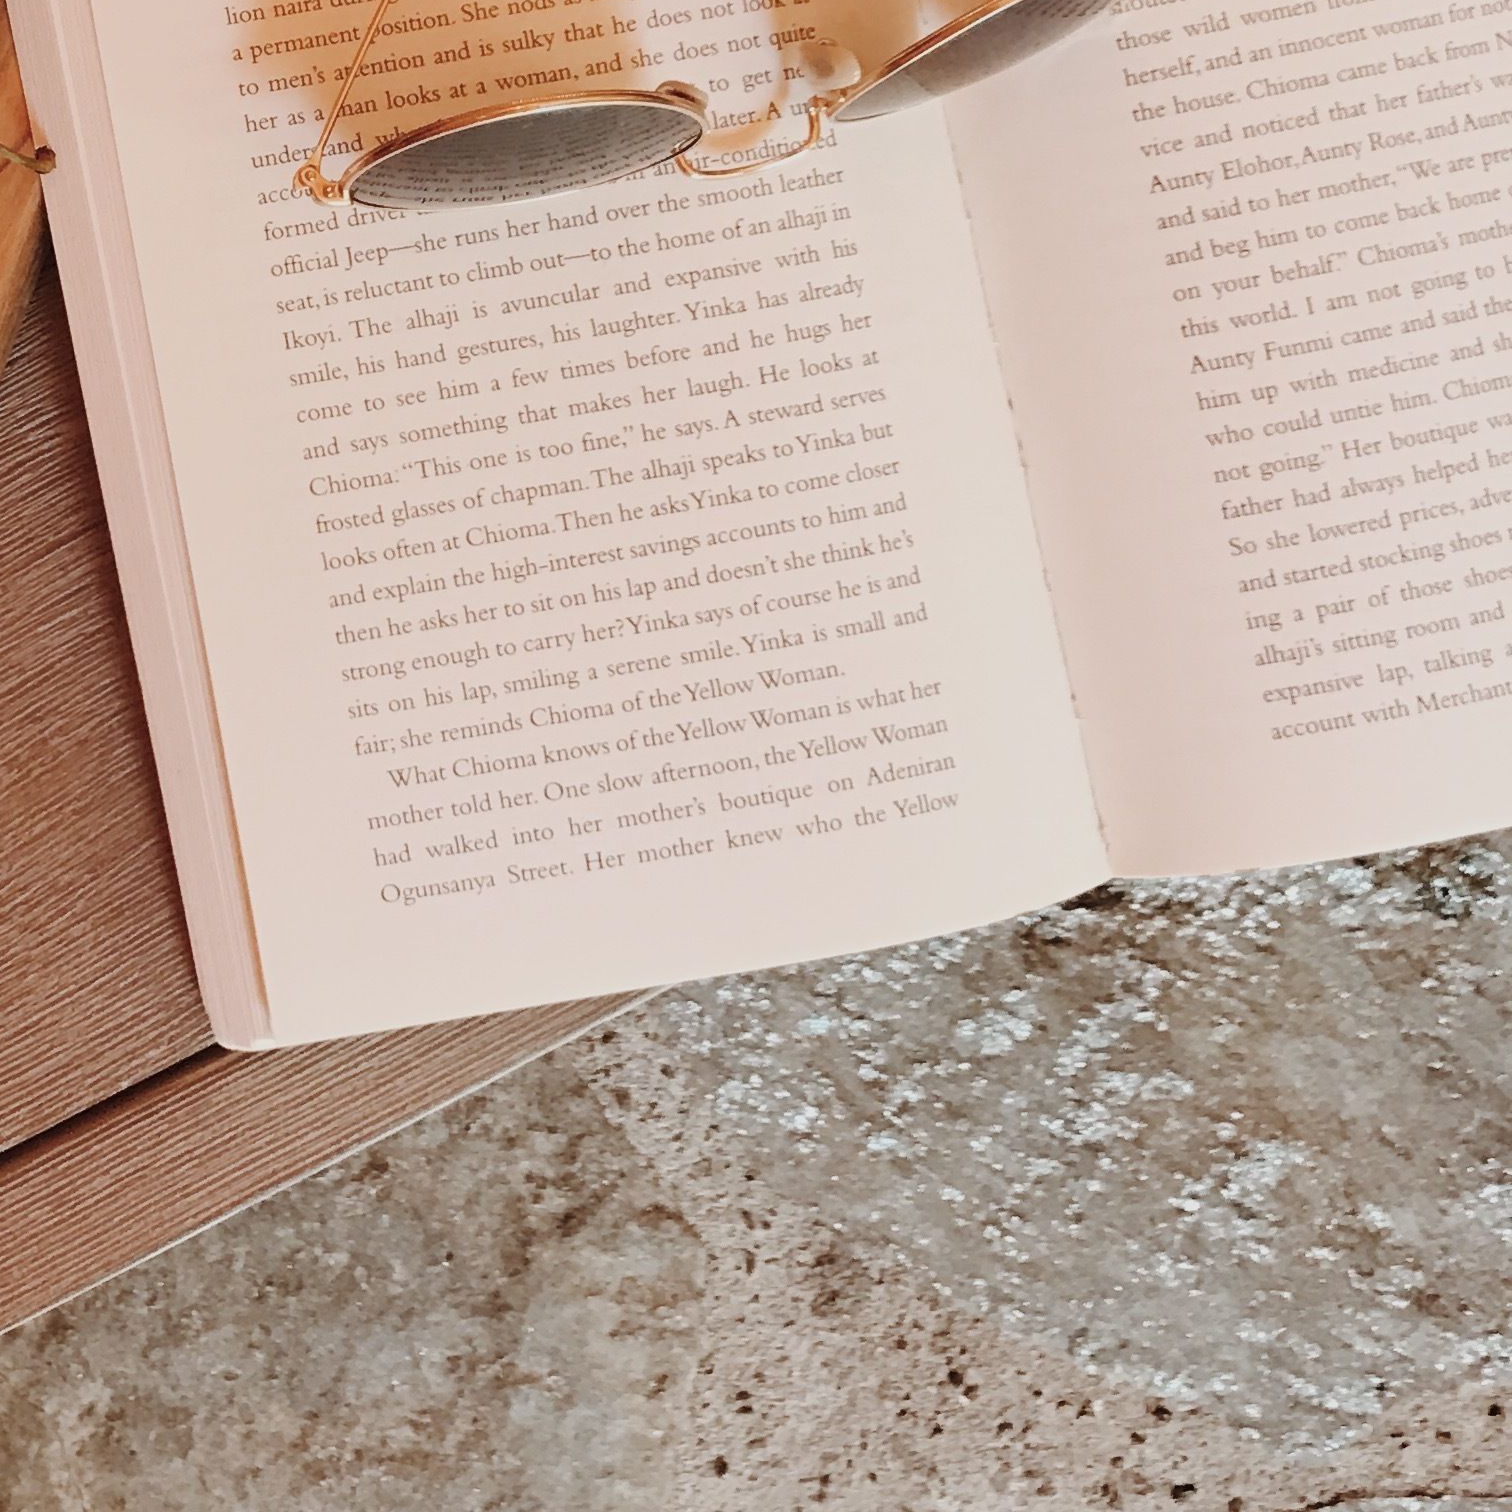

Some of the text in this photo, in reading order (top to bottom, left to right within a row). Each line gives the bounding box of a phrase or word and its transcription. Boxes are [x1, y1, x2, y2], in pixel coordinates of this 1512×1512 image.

[223, 6, 267, 26] lion
[1115, 29, 1172, 51] those
[1182, 11, 1230, 37] wild
[1240, 1, 1317, 25] women
[270, 247, 340, 278] official
[453, 227, 500, 248] runs
[504, 218, 541, 239] her
[545, 204, 600, 232] hand
[605, 202, 651, 222] over
[657, 192, 691, 214] the
[697, 176, 774, 208] smooth
[777, 167, 844, 194] leather
[1156, 205, 1196, 230] and
[1201, 196, 1242, 222] said
[1247, 198, 1270, 212] to
[1275, 188, 1311, 207] her
[1447, 156, 1475, 173] are
[281, 238, 858, 351] Ikoyi. The alhaji is avuncular and expansive with his
[1180, 316, 1220, 338] this
[1306, 296, 1315, 315] I
[1326, 294, 1358, 311] am
[1366, 283, 1402, 303] not
[1411, 271, 1468, 299] going
[1475, 266, 1495, 280] to
[302, 350, 880, 461] and says something that makes her laugh. He looks at
[1195, 337, 1485, 411] him up with medicine and
[329, 491, 908, 609] and explain the high-interest savings accounts to him and
[1228, 537, 1258, 556] So
[1266, 530, 1300, 550] she
[1307, 509, 1392, 542] lowered
[1271, 712, 1356, 740] account
[1361, 698, 1410, 723] with
[372, 842, 412, 868] had
[424, 829, 500, 859] walked
[511, 826, 555, 846] into
[567, 816, 603, 837] her
[717, 784, 813, 812] boutique
[827, 777, 855, 793] on
[867, 756, 956, 787] Adeniran
[380, 793, 958, 907] Ogunsanya Street. Her mother knew who the Yellow
